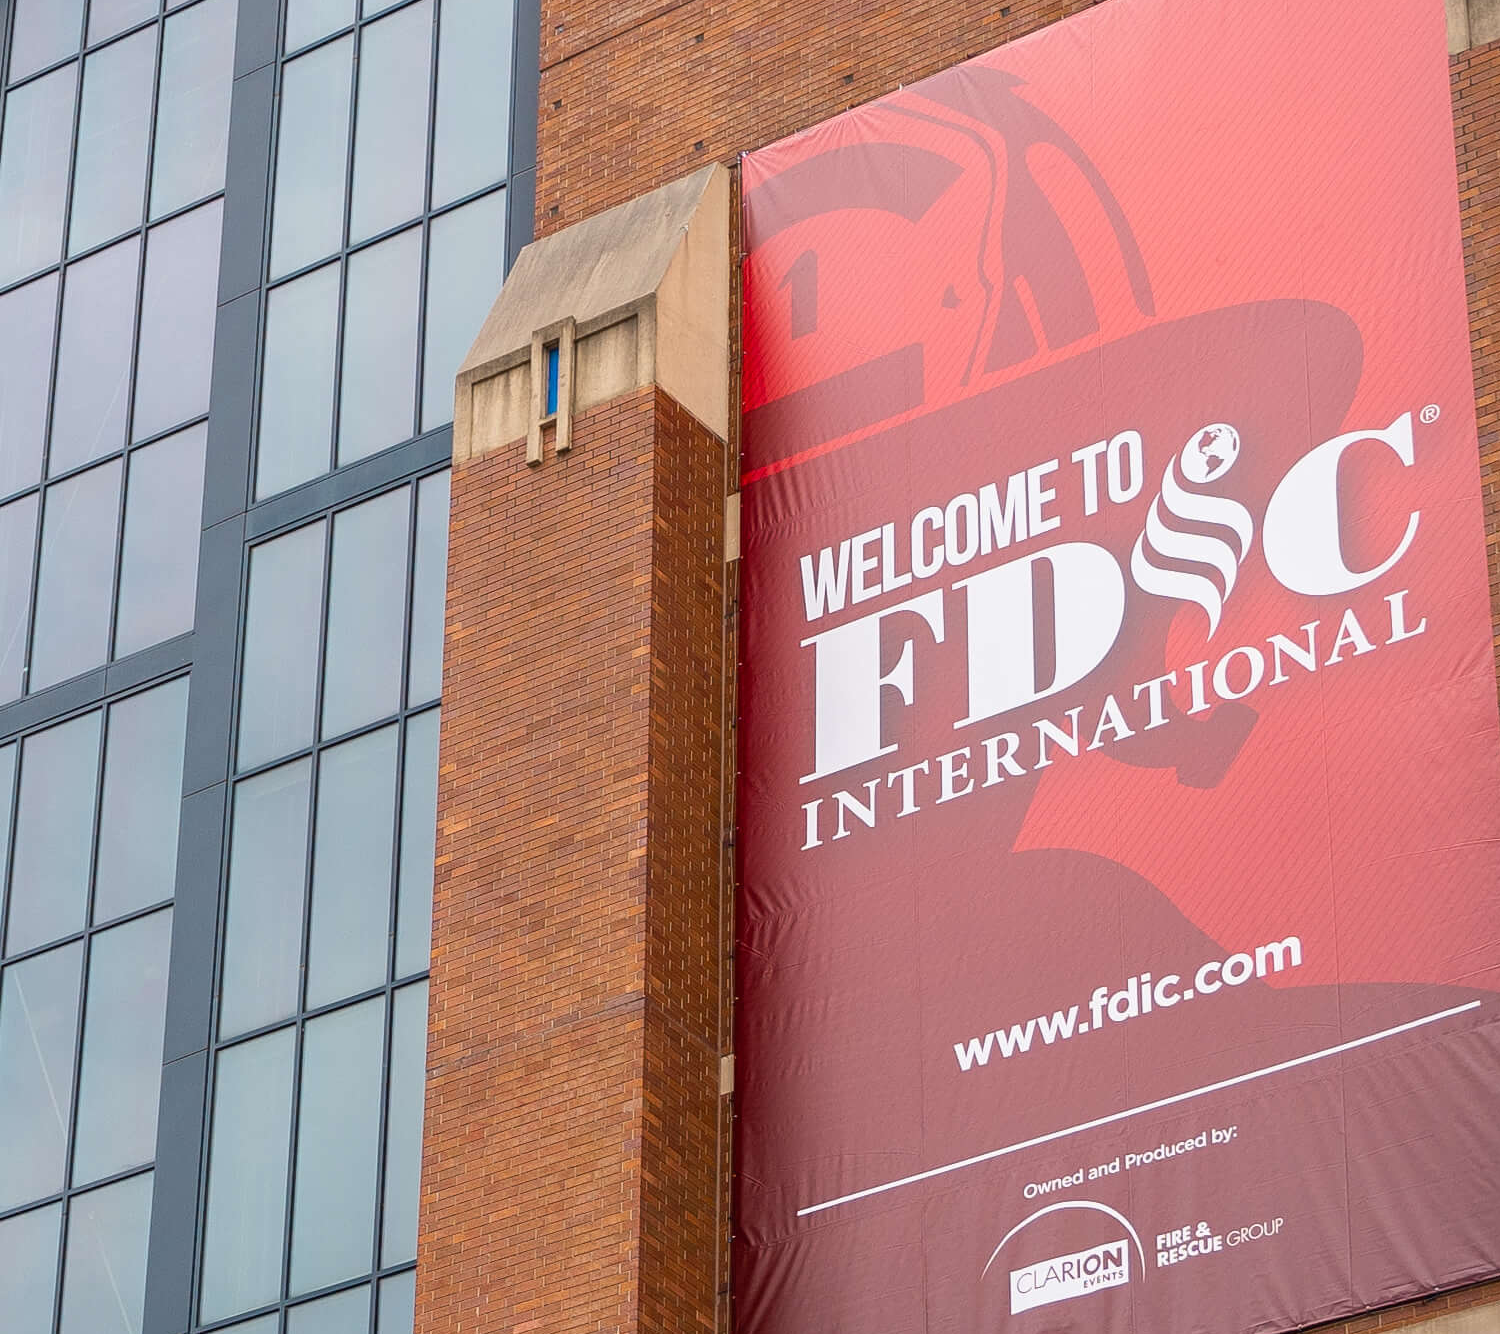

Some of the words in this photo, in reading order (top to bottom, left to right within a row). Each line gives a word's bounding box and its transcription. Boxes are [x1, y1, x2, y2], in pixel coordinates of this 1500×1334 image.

[799, 459, 1062, 622] WELCOME
[1072, 429, 1145, 516] TO
[801, 589, 1429, 852] INTERNATIONAL
[953, 934, 1302, 1071] www.fdic.com
[1023, 1169, 1084, 1199] Owned
[1088, 1157, 1120, 1180] and
[1125, 1132, 1207, 1170] Produced
[1211, 1126, 1238, 1145] by:
[1156, 1225, 1192, 1251] FIRE
[1195, 1221, 1212, 1238] &
[1157, 1235, 1223, 1268] RESCUE
[1226, 1217, 1285, 1247] GROUP
[1016, 1247, 1123, 1294] CLARION
[1083, 1269, 1124, 1289] EVENTS
